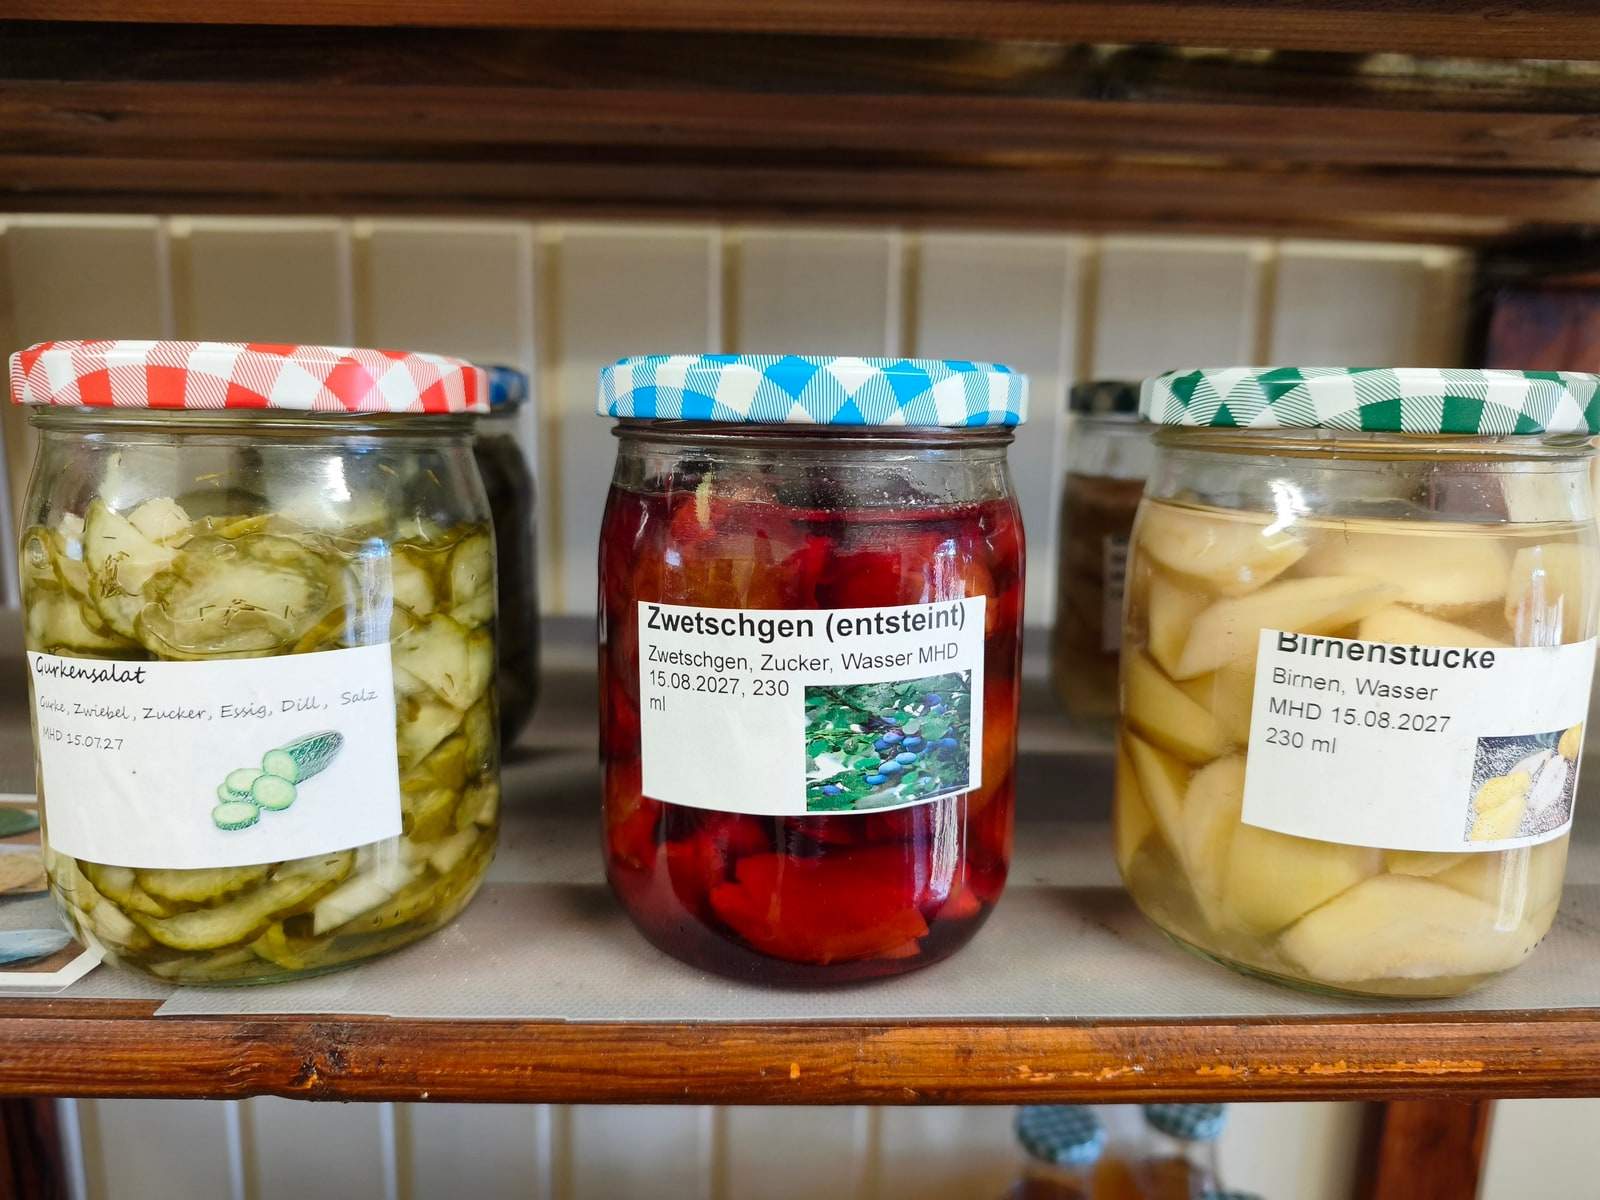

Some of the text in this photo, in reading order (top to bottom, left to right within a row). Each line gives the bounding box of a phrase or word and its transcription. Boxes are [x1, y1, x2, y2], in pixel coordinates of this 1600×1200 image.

[648, 602, 965, 643] Zwetschgen (entsteint)
[35, 656, 146, 684] Gurkensalat
[648, 642, 958, 673] Zwetschgen, Zucker, Wasser MHD
[650, 670, 789, 697] 15.08.2027, 230
[1273, 667, 1438, 700] Birnen, Wasser
[40, 688, 378, 721] Gurke, Zwiebel, Zucker, Essig, Dill, Salz
[650, 696, 666, 712] ml
[1269, 697, 1450, 733] MHD 15.08.2027
[43, 727, 124, 750] MHD 15.07.27
[1265, 727, 1336, 754] 230 ml
